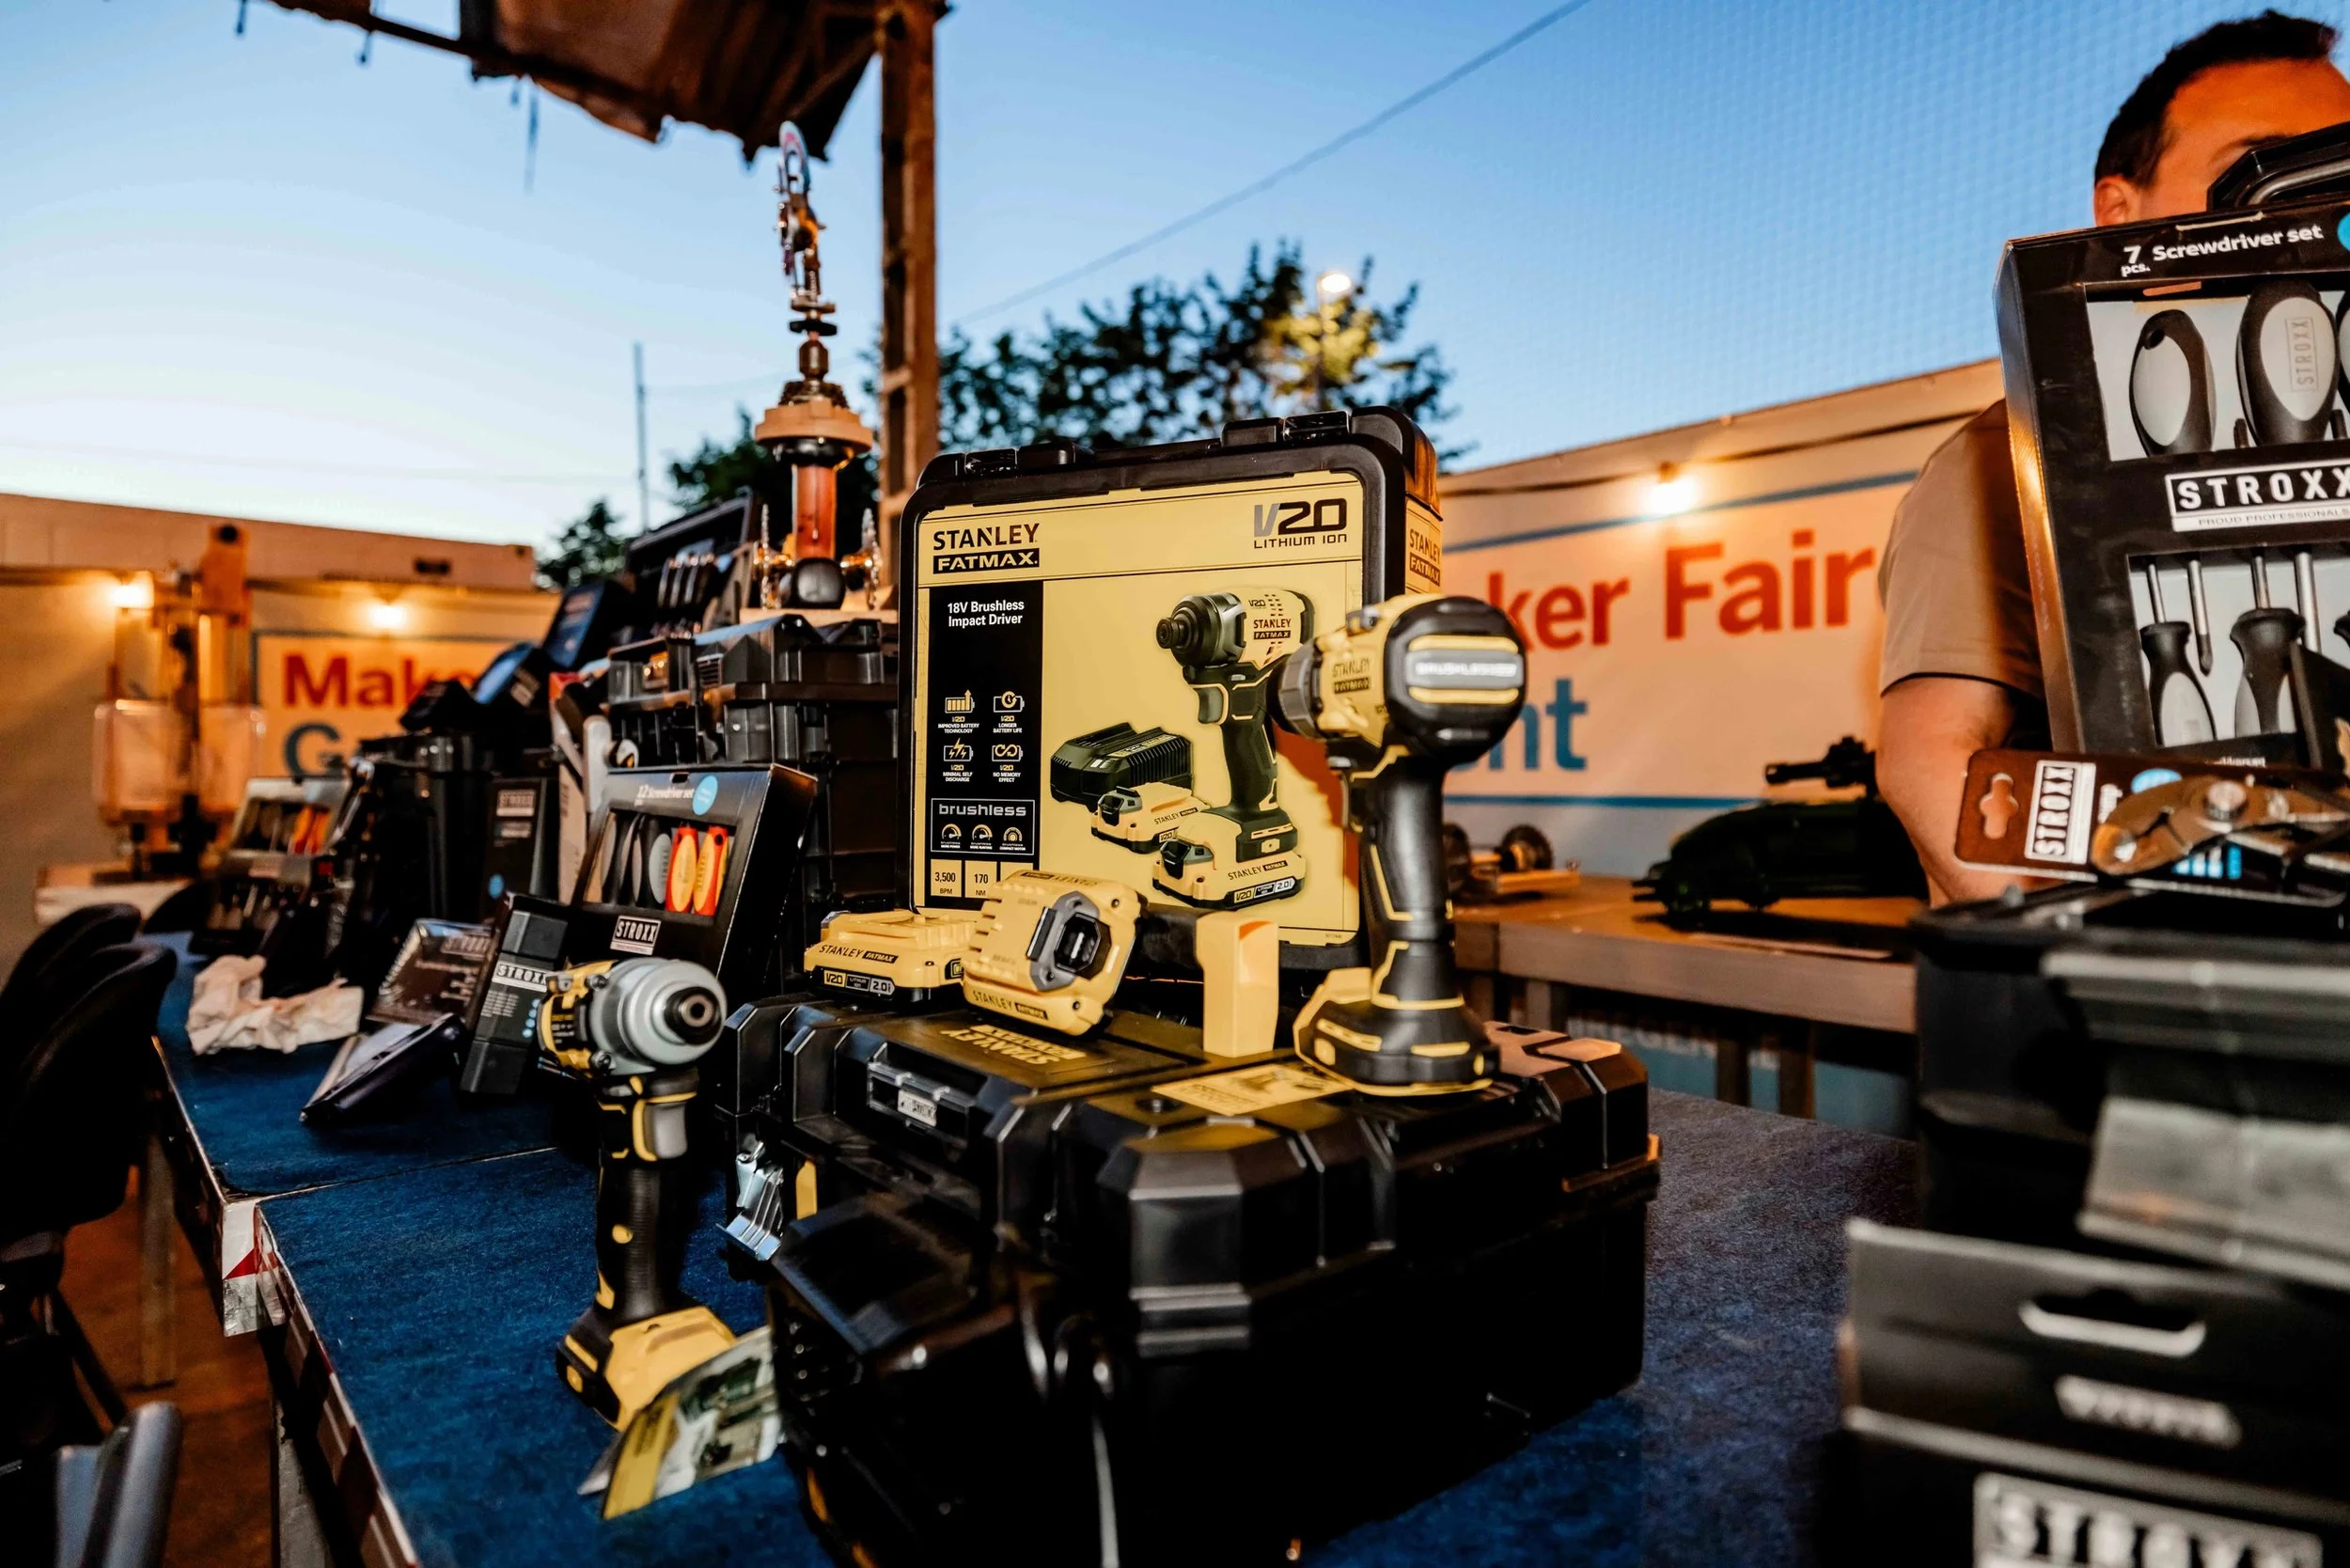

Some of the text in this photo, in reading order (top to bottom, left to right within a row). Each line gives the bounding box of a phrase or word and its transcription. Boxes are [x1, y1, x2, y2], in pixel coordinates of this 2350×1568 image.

[2123, 224, 2325, 264] 7 Screwdriver set
[2121, 262, 2151, 277] pcs.
[2290, 318, 2315, 386] STROXX
[2177, 467, 2350, 510] STROXX
[1254, 498, 1347, 537] V20
[2199, 516, 2243, 526] PROUD
[933, 523, 1040, 551] STANLEY
[1254, 534, 1347, 549] LITHIUM ION
[1410, 528, 1440, 564] STANLEY
[948, 600, 1025, 614] 18V Brushless
[948, 613, 1023, 629] Impact Driver
[1254, 619, 1291, 629] STANLEY
[1255, 631, 1291, 639] FATMAX
[939, 804, 1026, 816] brushless
[935, 872, 956, 883] 3,500
[974, 874, 988, 884] 170
[1228, 866, 1262, 880] STANLEY
[616, 920, 656, 943] STROXX
[819, 945, 863, 958] STANLEY
